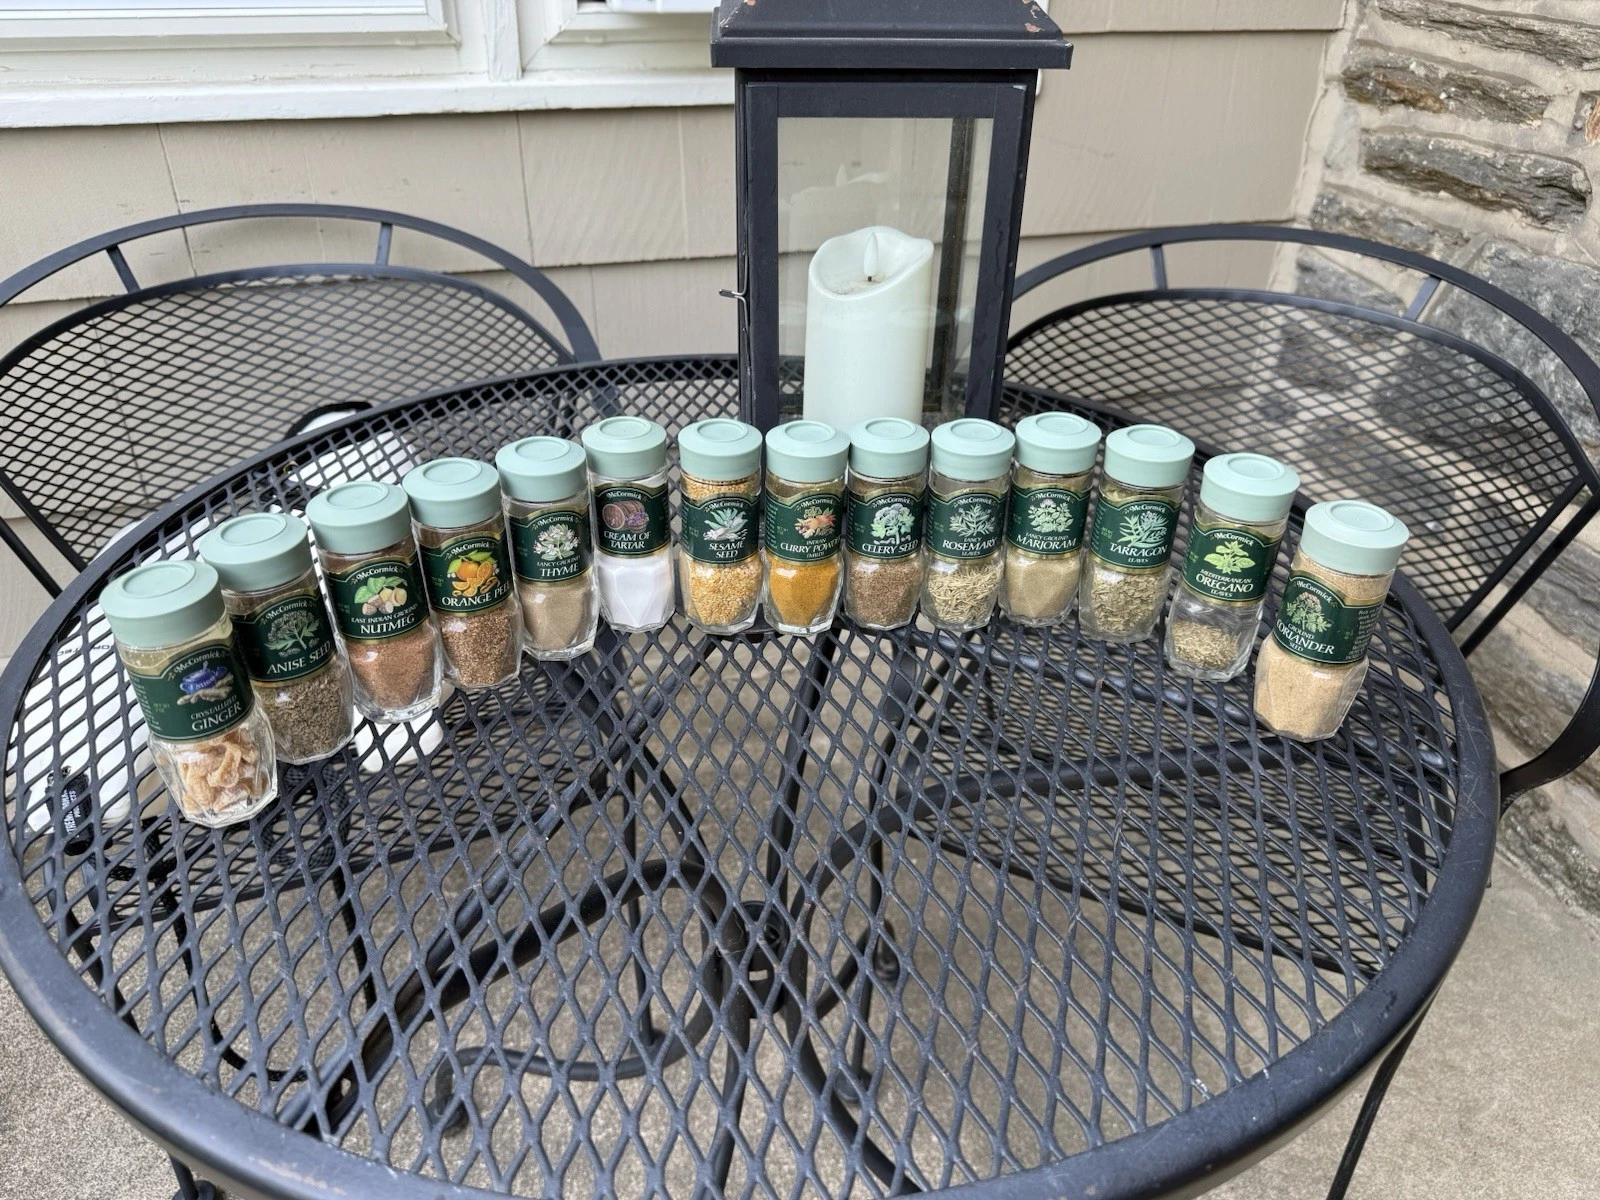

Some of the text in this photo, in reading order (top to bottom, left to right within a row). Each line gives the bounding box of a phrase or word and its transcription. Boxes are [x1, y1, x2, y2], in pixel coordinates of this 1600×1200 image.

[606, 491, 642, 500] McCormick
[877, 497, 911, 506] McCormick
[957, 497, 992, 505] McCormick
[1036, 492, 1071, 502] McCormick
[709, 501, 744, 509] McCormick
[800, 498, 833, 508] McCormick
[1129, 504, 1166, 513] McCormick
[537, 515, 574, 526] McCormick
[603, 530, 651, 541] CREAM OF
[1016, 534, 1077, 550] MARJORAM
[1025, 532, 1043, 540] FANCY
[1214, 532, 1254, 546] McCormick
[450, 541, 490, 555] McCormick
[609, 540, 645, 550] TARTAR
[708, 541, 745, 551] SESAME
[780, 542, 812, 553] CURRY
[862, 540, 919, 554] CELERY SEED
[942, 537, 997, 551] ROSEMARY
[1109, 542, 1168, 557] TARRAGON
[716, 550, 739, 558] SEED
[355, 565, 399, 580] McCormick
[540, 563, 579, 577] THYME
[1200, 569, 1253, 583] MEDITERRANEAN
[1195, 573, 1254, 592] OREGANO
[441, 581, 510, 607] ORANGE PEEL
[1210, 588, 1233, 597] LEAVES
[1296, 580, 1333, 604] McCormick
[266, 600, 308, 620] McCormick
[367, 614, 393, 623] INDIAN
[393, 603, 419, 618] GROUND
[360, 613, 415, 634] NUTMEG
[1287, 623, 1315, 640] GROUND
[1289, 641, 1304, 652] SEED
[174, 650, 221, 674] McCormick
[266, 640, 331, 675] ANISE SEED
[190, 694, 238, 720] CRYSTALLIZED
[191, 701, 242, 732] GINGER
